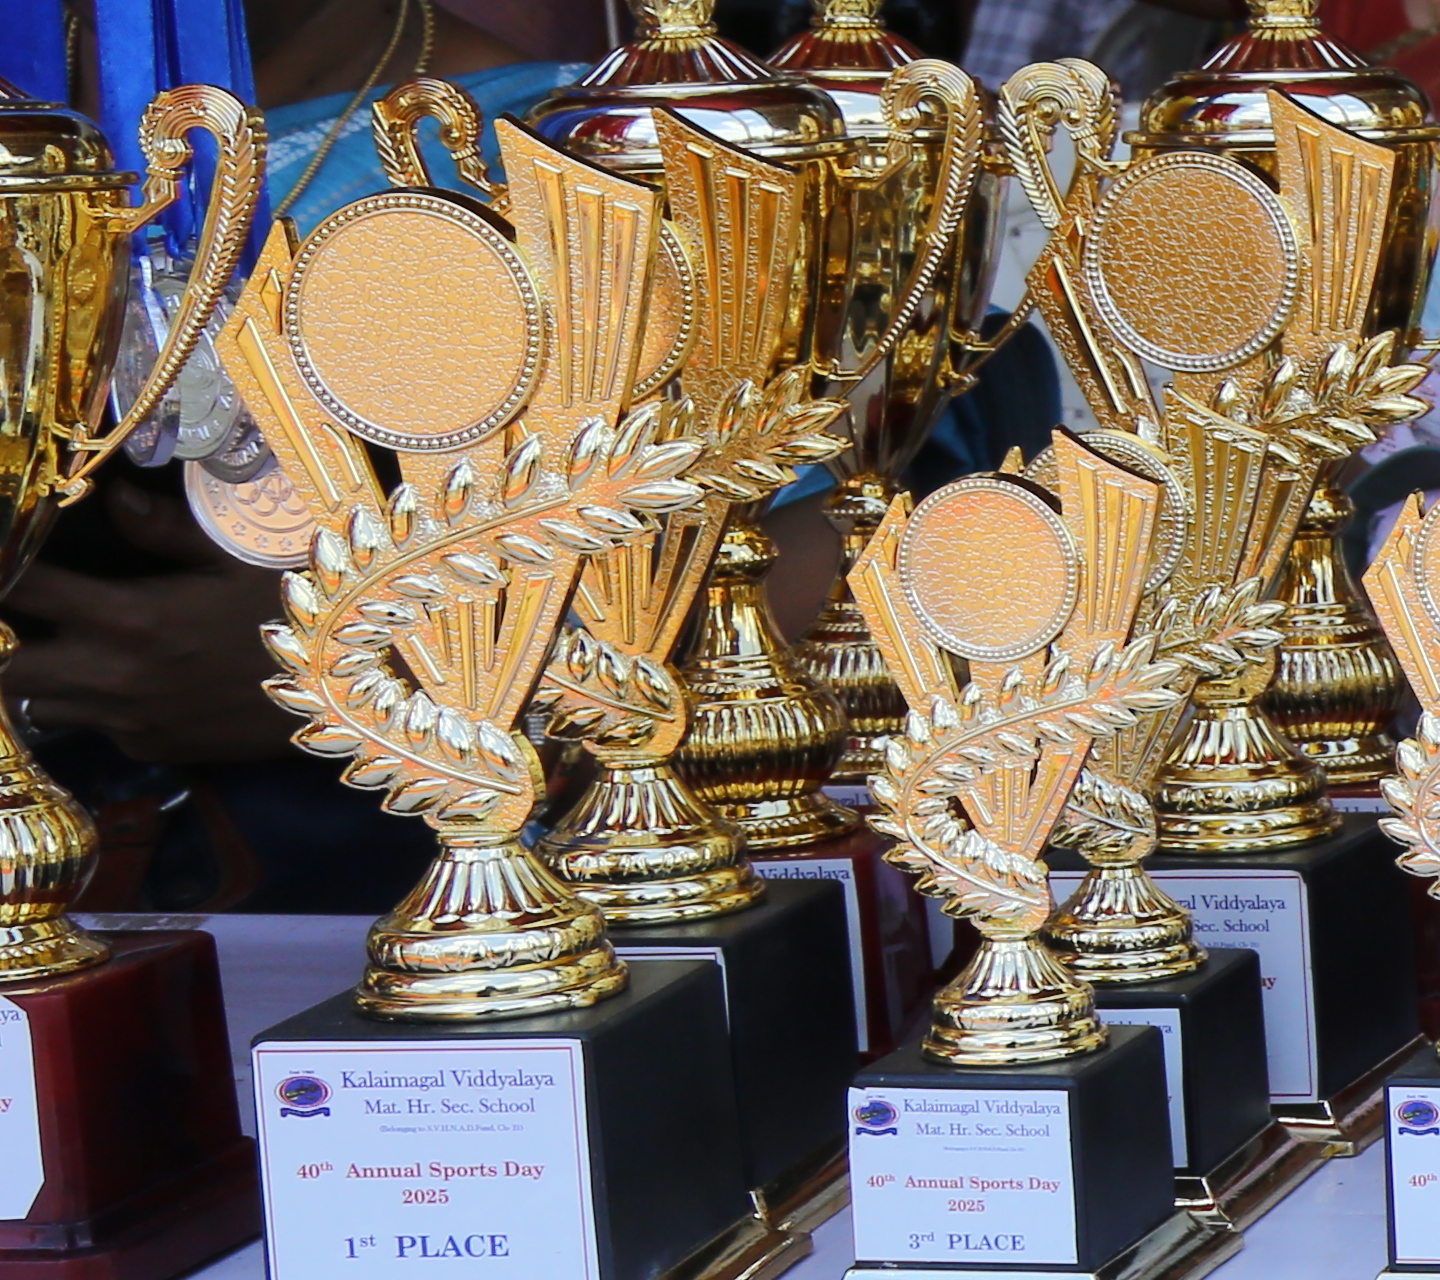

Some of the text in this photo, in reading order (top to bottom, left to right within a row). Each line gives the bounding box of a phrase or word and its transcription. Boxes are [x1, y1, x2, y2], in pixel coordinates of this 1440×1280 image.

[1200, 895, 1285, 913] Viddyalaya
[1223, 919, 1269, 932] School
[341, 1069, 556, 1091] Kalaimagal Viddyalaya
[364, 1097, 535, 1114] Mat. Hr. Sec. School
[903, 1099, 1061, 1117] Kalaimagal Viddyalaya
[916, 1123, 1050, 1137] Mat. Hr. Sec. School
[297, 1161, 544, 1181] 40th Annual Sports Day
[1409, 1173, 1437, 1187] 40th
[867, 1174, 1060, 1193] 40th Annual Sports Day
[402, 1189, 449, 1204] 2025
[948, 1199, 985, 1212] 2025
[345, 1235, 509, 1258] 1st PLACE
[909, 1232, 1025, 1250] 3rd PLACE
